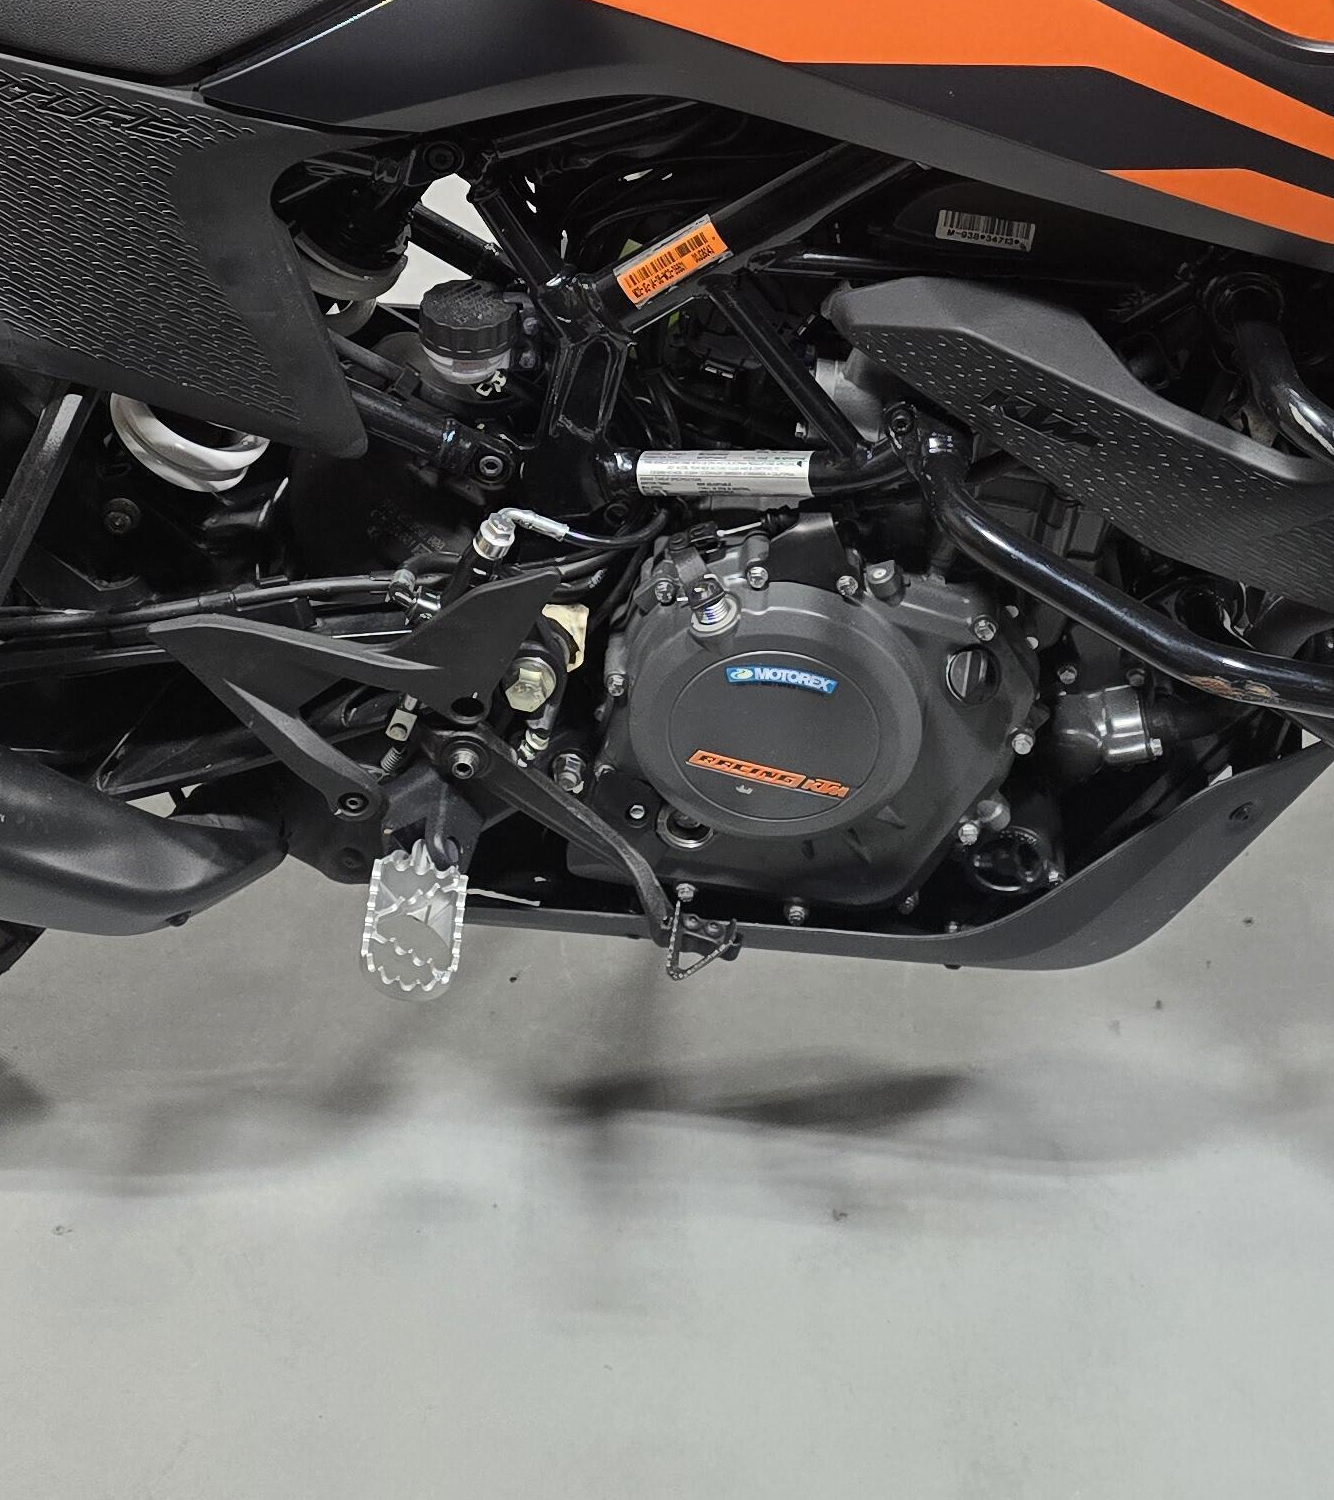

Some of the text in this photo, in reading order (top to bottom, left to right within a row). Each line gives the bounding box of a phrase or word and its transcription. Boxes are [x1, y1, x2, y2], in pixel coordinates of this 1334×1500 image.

[754, 667, 833, 693] MOTOREX
[698, 754, 850, 799] RACING KTM
